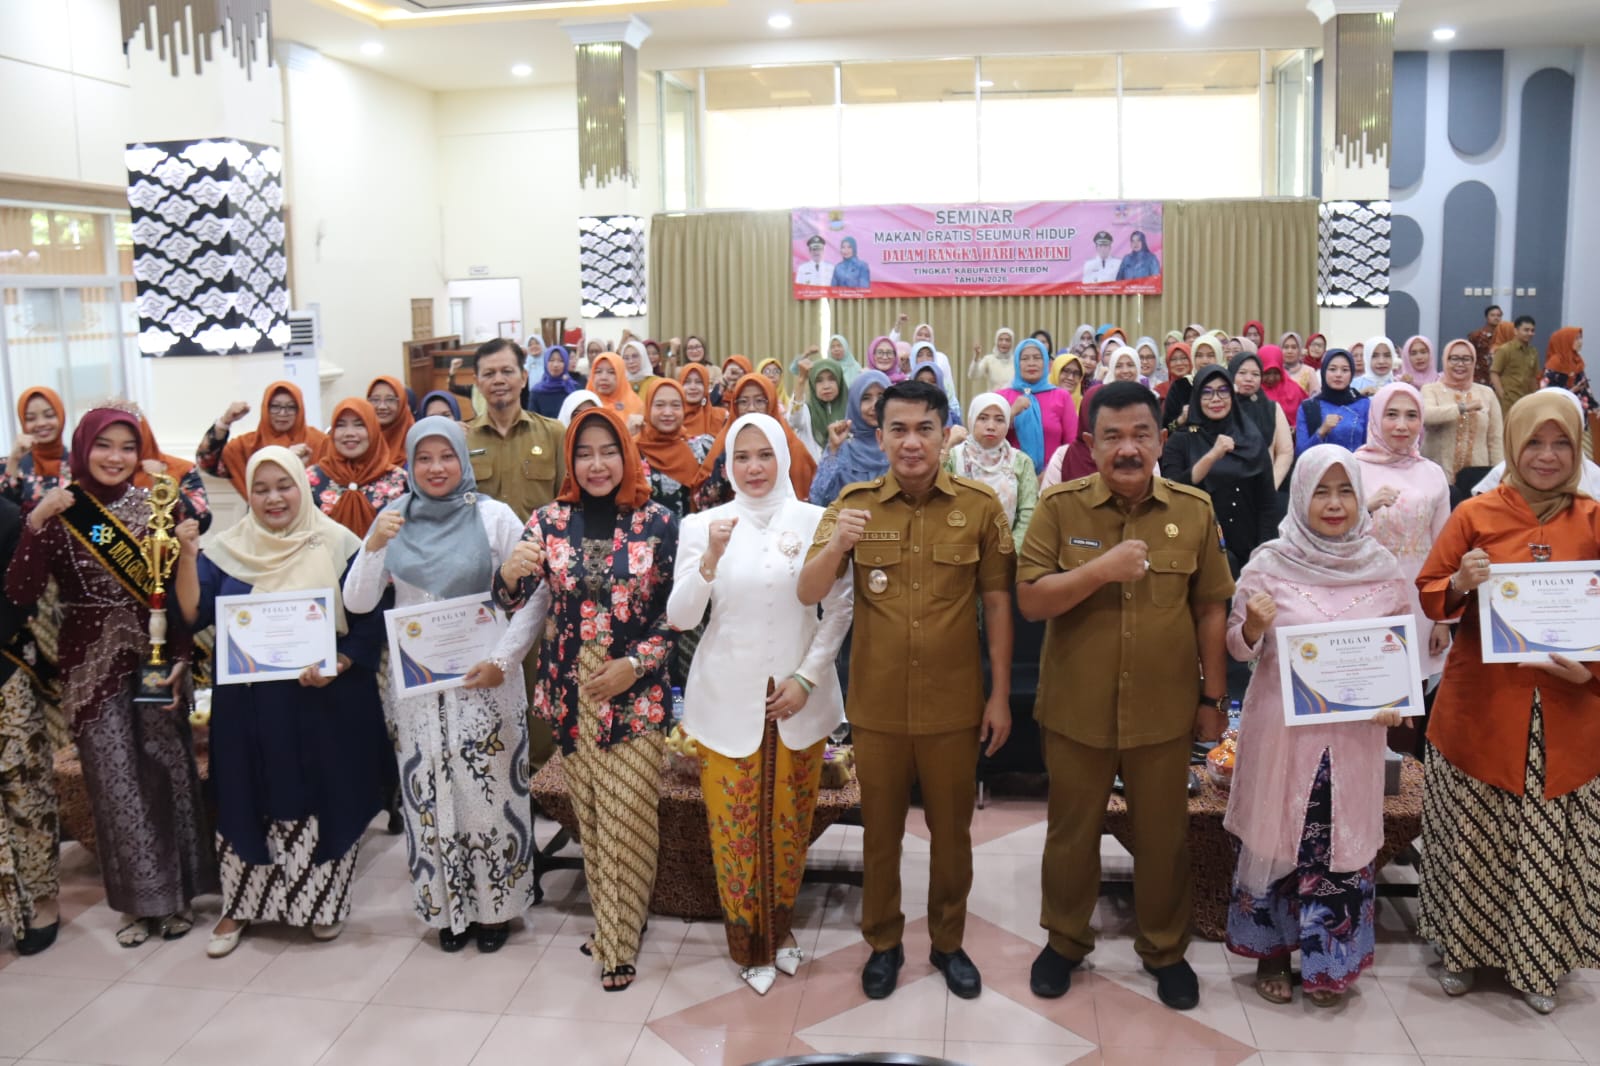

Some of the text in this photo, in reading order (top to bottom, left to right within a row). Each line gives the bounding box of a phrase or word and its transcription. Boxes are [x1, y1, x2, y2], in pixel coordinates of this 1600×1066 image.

[936, 209, 1013, 225] SEMINAR
[874, 228, 1076, 243] MAKAN GRATIS SEUMUR HIDUP
[883, 246, 1069, 261] DALAM RANGKA HARI KARTINI
[913, 267, 951, 275] TINGKAT
[954, 266, 1007, 274] KABUPATEN
[108, 541, 135, 568] DUTA
[1531, 578, 1575, 587] PIAGAM
[1329, 635, 1371, 646] PIAGAM
